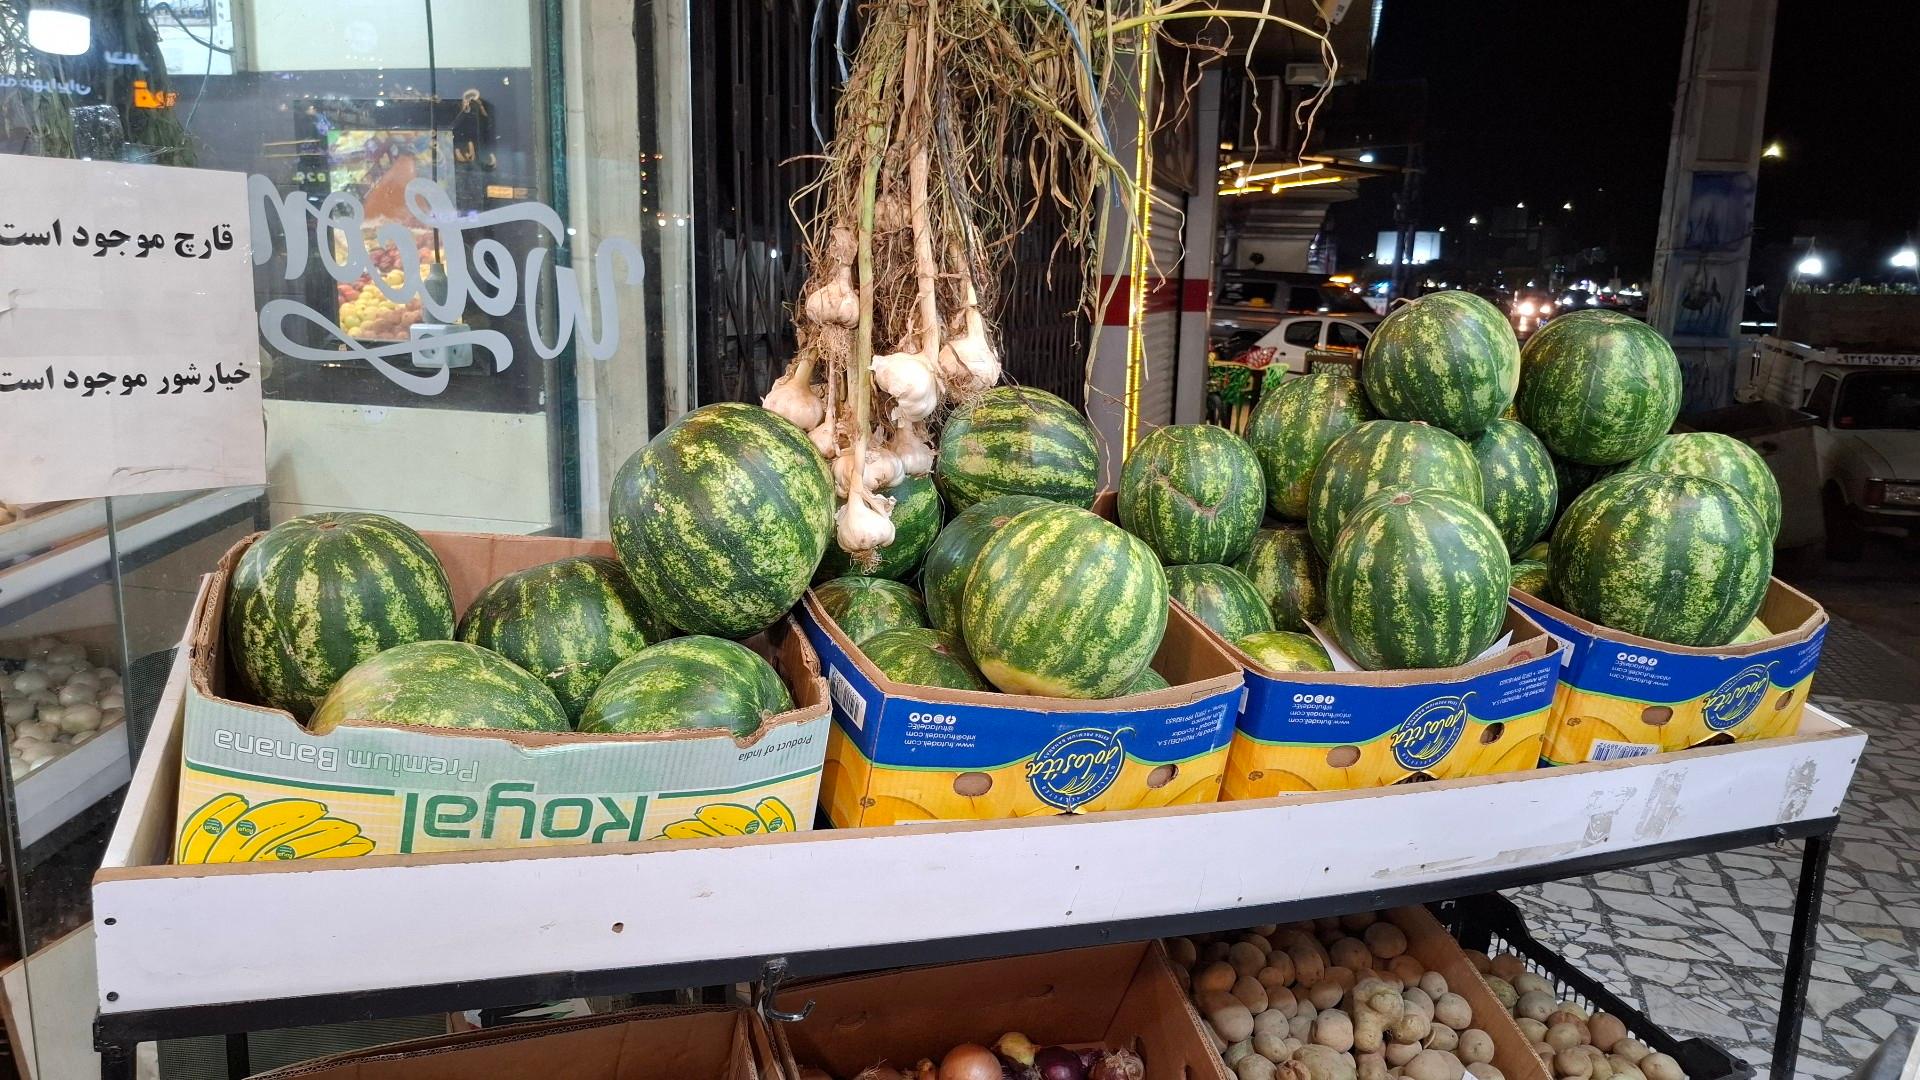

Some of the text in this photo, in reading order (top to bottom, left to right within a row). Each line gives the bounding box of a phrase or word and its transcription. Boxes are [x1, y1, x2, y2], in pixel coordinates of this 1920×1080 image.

[0, 218, 234, 260] قارچ موجود است
[0, 364, 54, 392] است
[63, 369, 148, 397] موجود
[213, 729, 481, 784] Premium Banana
[738, 734, 813, 762] Product of India
[400, 782, 648, 854] Royal
